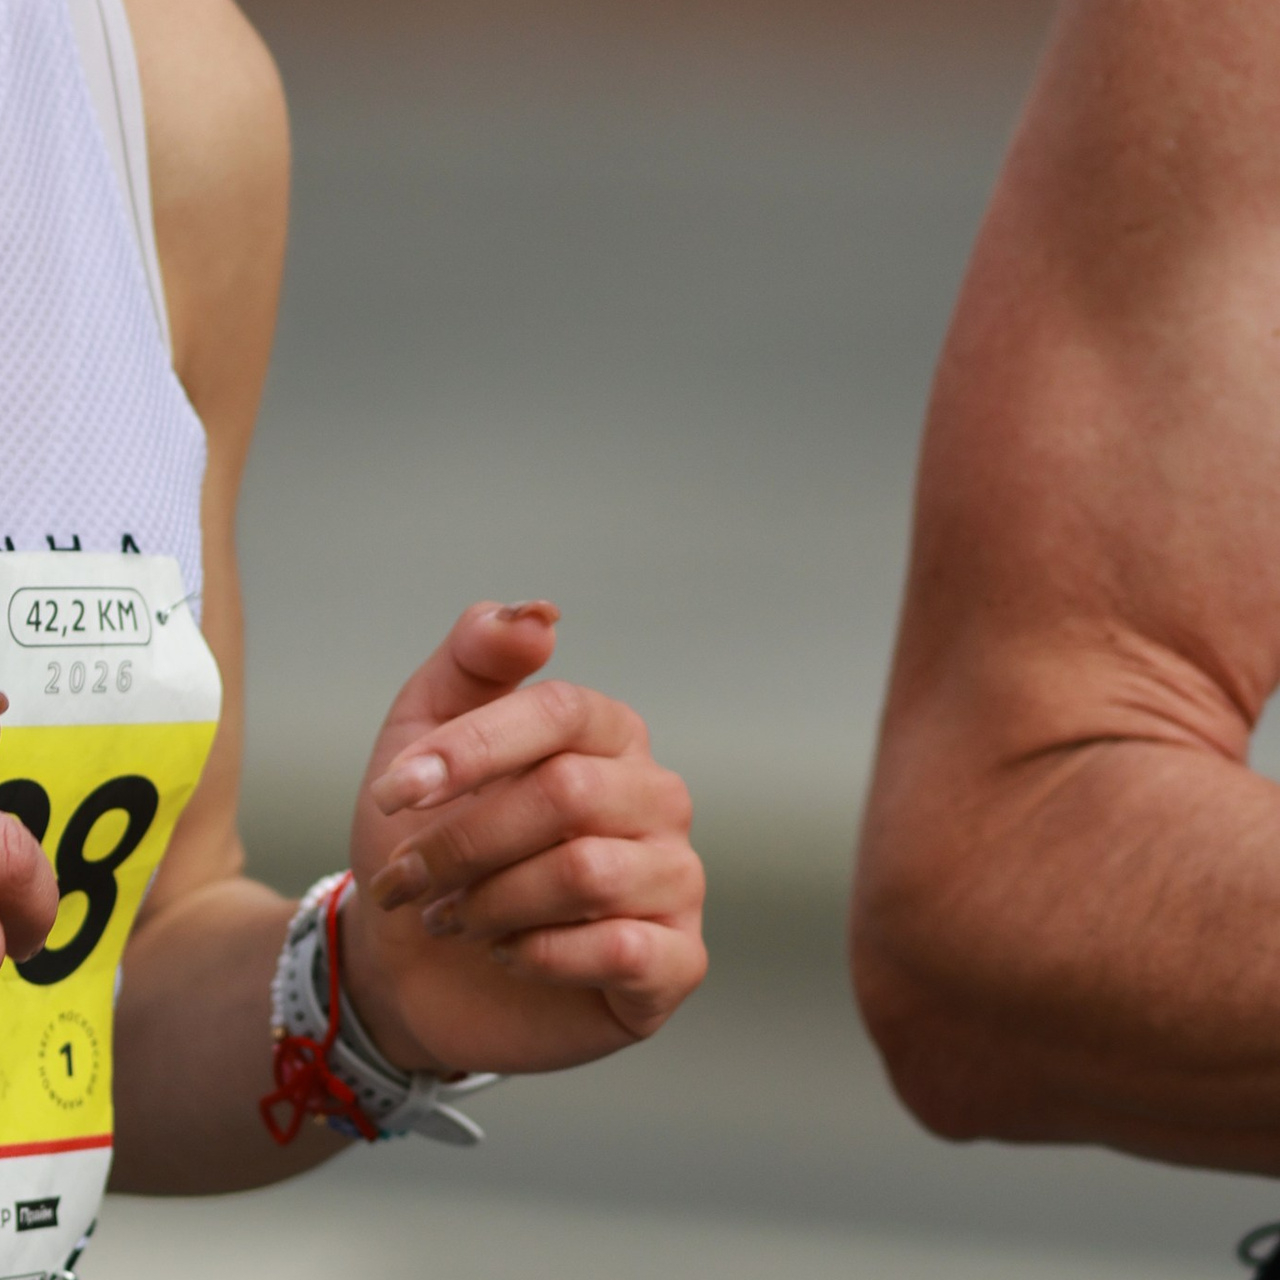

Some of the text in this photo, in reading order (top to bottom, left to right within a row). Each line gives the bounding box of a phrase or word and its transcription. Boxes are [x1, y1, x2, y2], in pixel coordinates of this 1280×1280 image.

[26, 599, 139, 637] 42,2 КМ
[44, 660, 133, 694] 2026
[59, 1041, 73, 1077] 1
